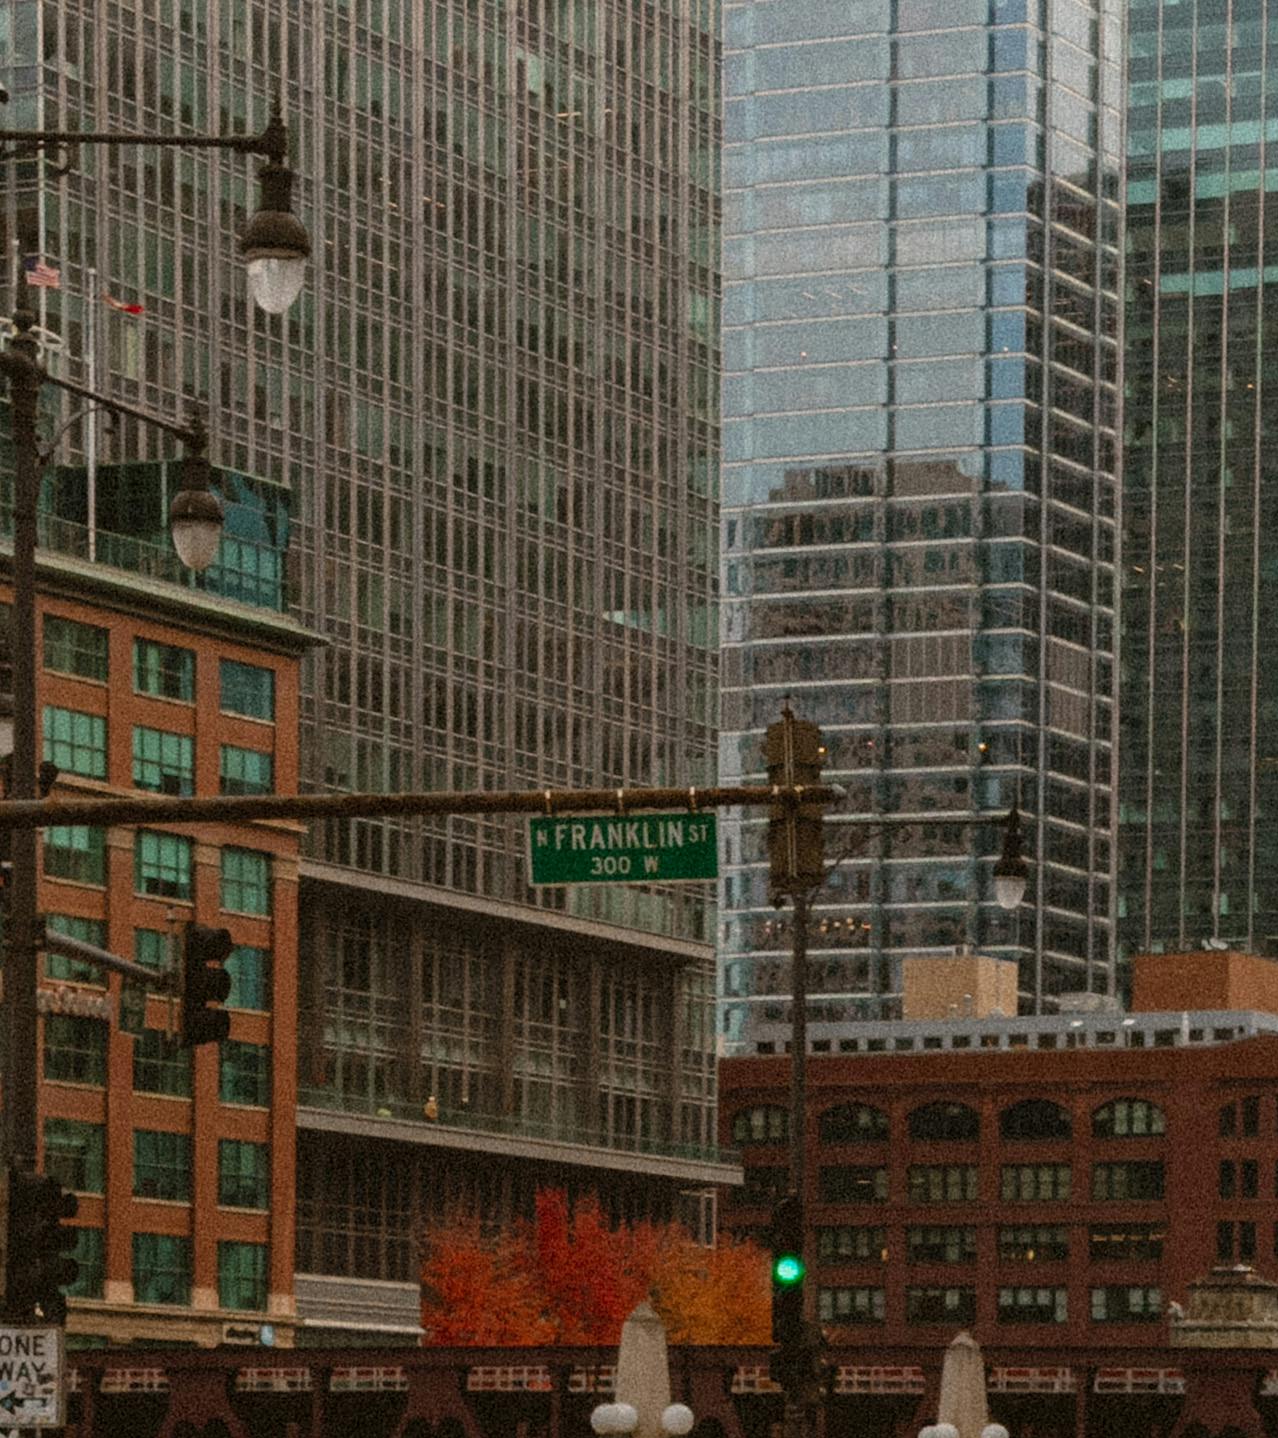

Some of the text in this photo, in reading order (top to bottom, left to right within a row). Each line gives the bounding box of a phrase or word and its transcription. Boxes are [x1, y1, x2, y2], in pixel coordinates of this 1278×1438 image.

[537, 821, 708, 850] N FRANKLIN ST
[591, 856, 659, 875] 300 W
[0, 1335, 45, 1356] ONE
[0, 1362, 46, 1382] WAY
